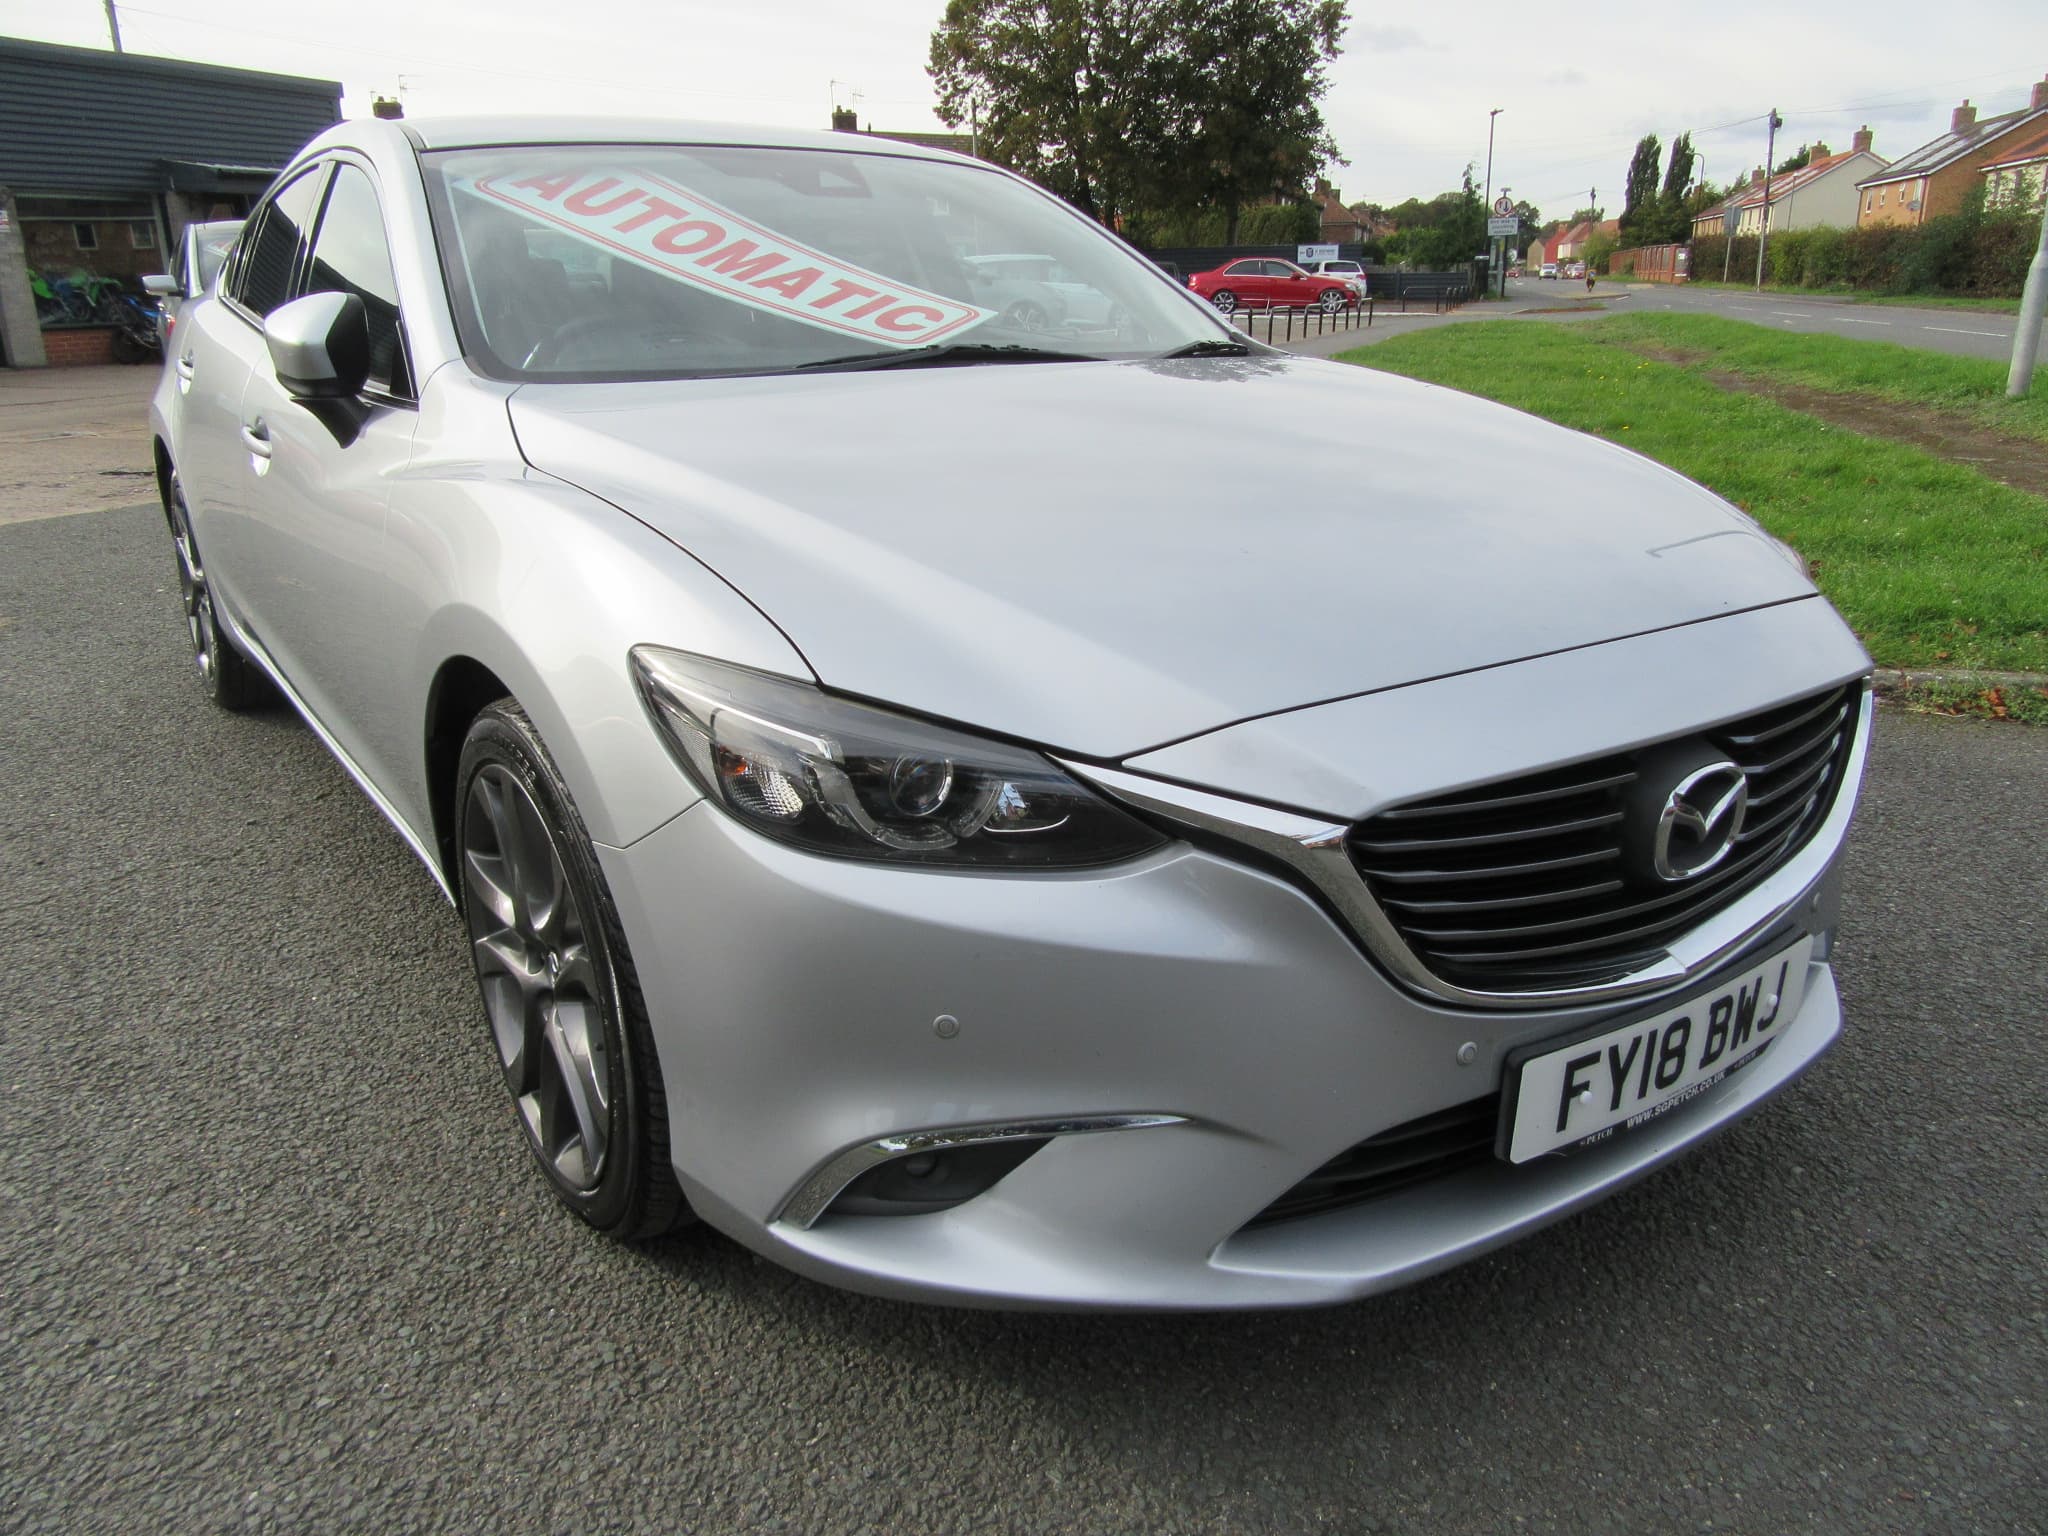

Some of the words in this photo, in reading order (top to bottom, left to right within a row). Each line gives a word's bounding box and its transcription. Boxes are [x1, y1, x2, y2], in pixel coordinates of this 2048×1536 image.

[513, 165, 945, 333] AUTOMATIC
[1555, 1016, 1692, 1133] FY18
[1698, 960, 1789, 1070] BWJ
[1626, 1071, 1726, 1129] WWW.SGPETCH.CO.UK
